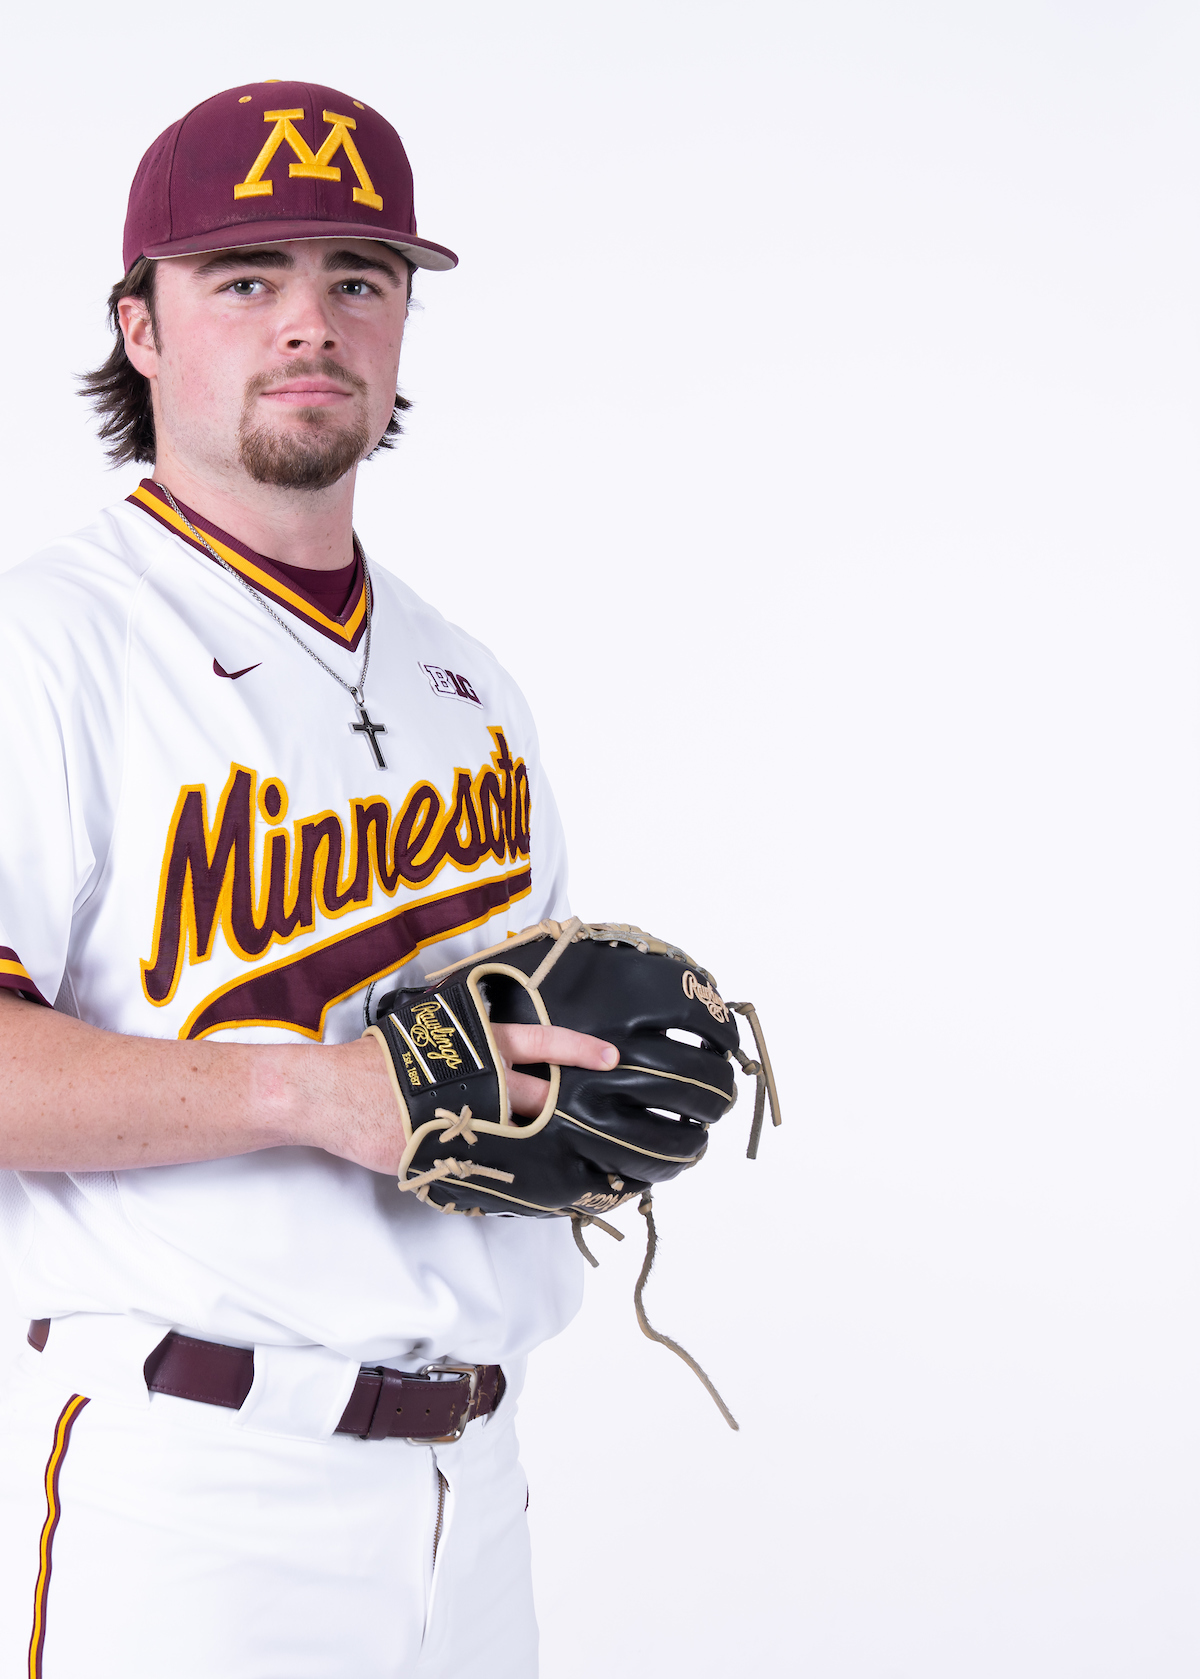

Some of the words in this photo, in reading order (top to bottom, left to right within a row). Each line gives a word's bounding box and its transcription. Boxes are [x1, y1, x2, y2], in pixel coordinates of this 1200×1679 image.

[233, 108, 384, 212] M
[139, 725, 532, 1007] Minnesota
[401, 1051, 412, 1069] Est.
[407, 1067, 422, 1086] 1887
[411, 1001, 463, 1070] Rawlings
